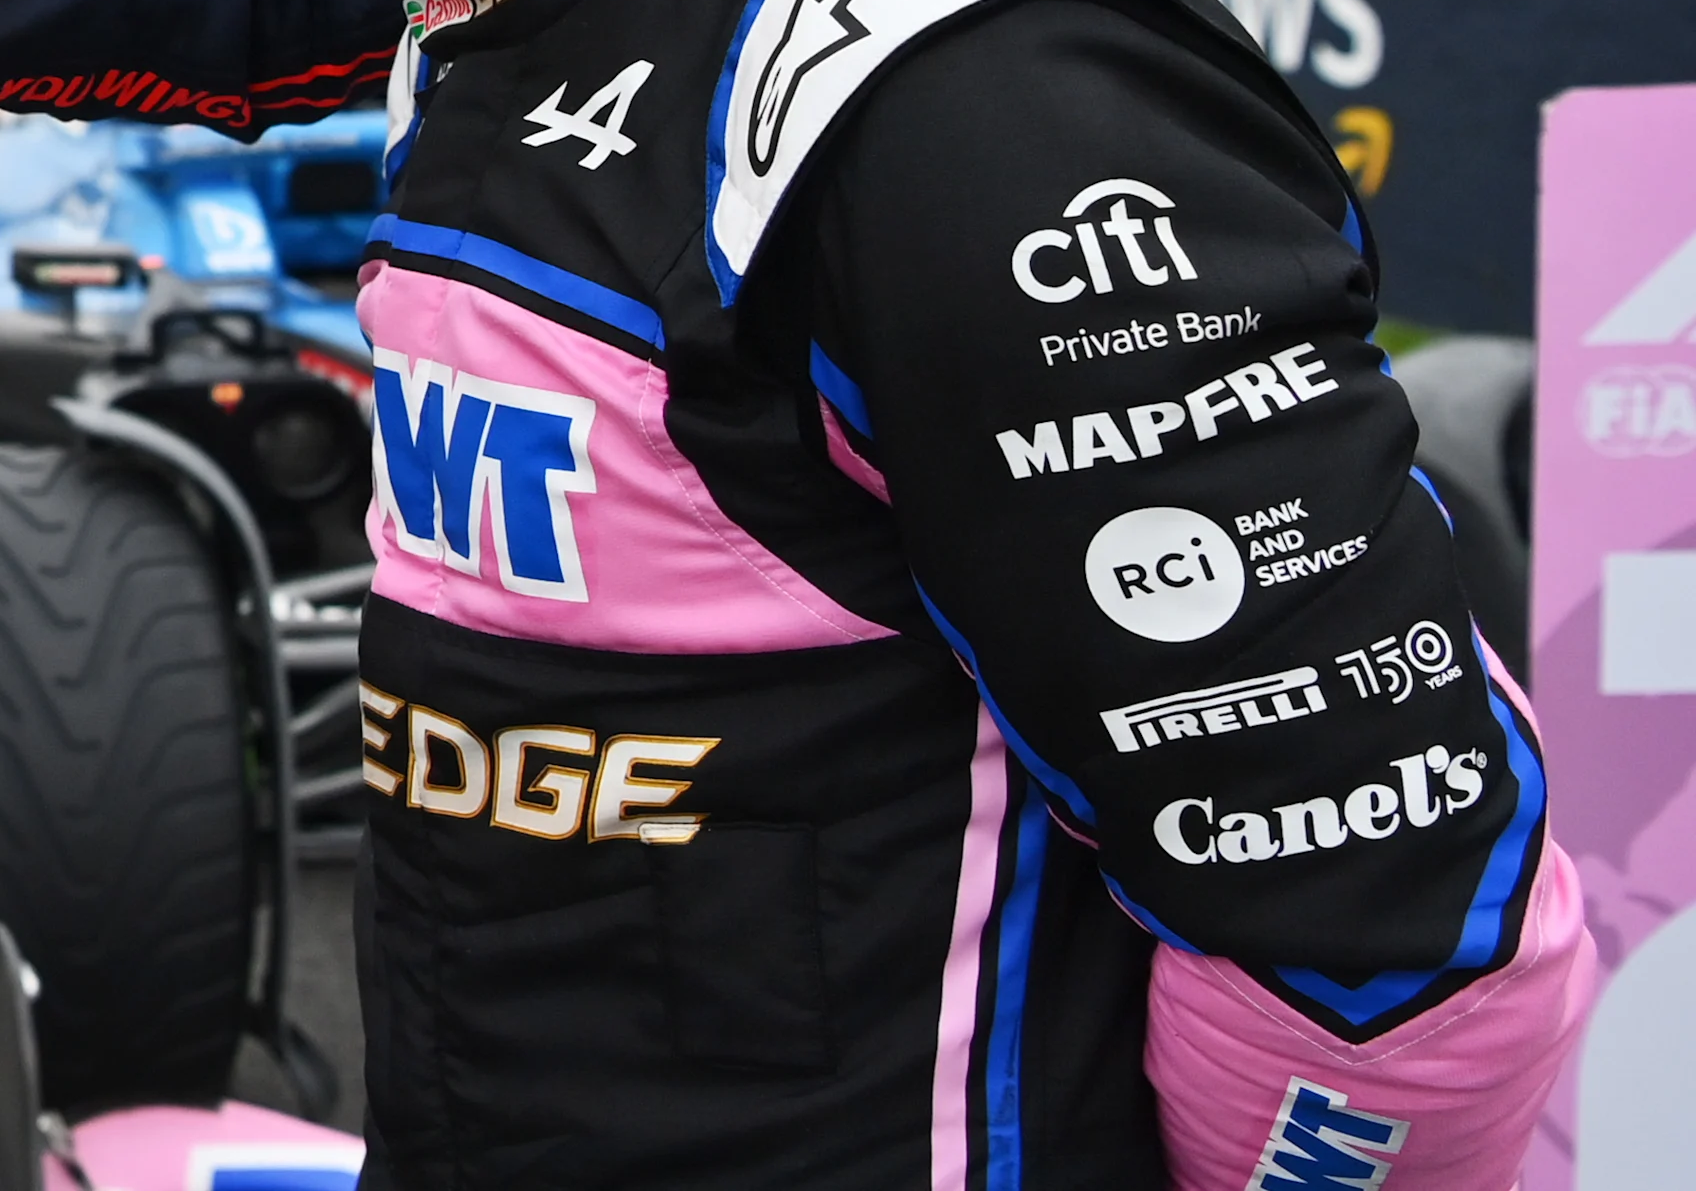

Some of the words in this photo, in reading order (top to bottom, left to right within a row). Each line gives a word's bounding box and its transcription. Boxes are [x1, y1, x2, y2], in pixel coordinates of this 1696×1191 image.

[1040, 317, 1170, 367] Private
[1176, 305, 1262, 349] Bank
[995, 341, 1340, 481] MAPFRE
[1234, 498, 1310, 538] BANK
[1248, 528, 1306, 563] AND
[1254, 534, 1370, 590] SERVICES
[1099, 665, 1328, 754] PIRELLI
[1335, 620, 1454, 705] 150
[1423, 665, 1464, 691] YEARS
[359, 678, 723, 845] EDGE
